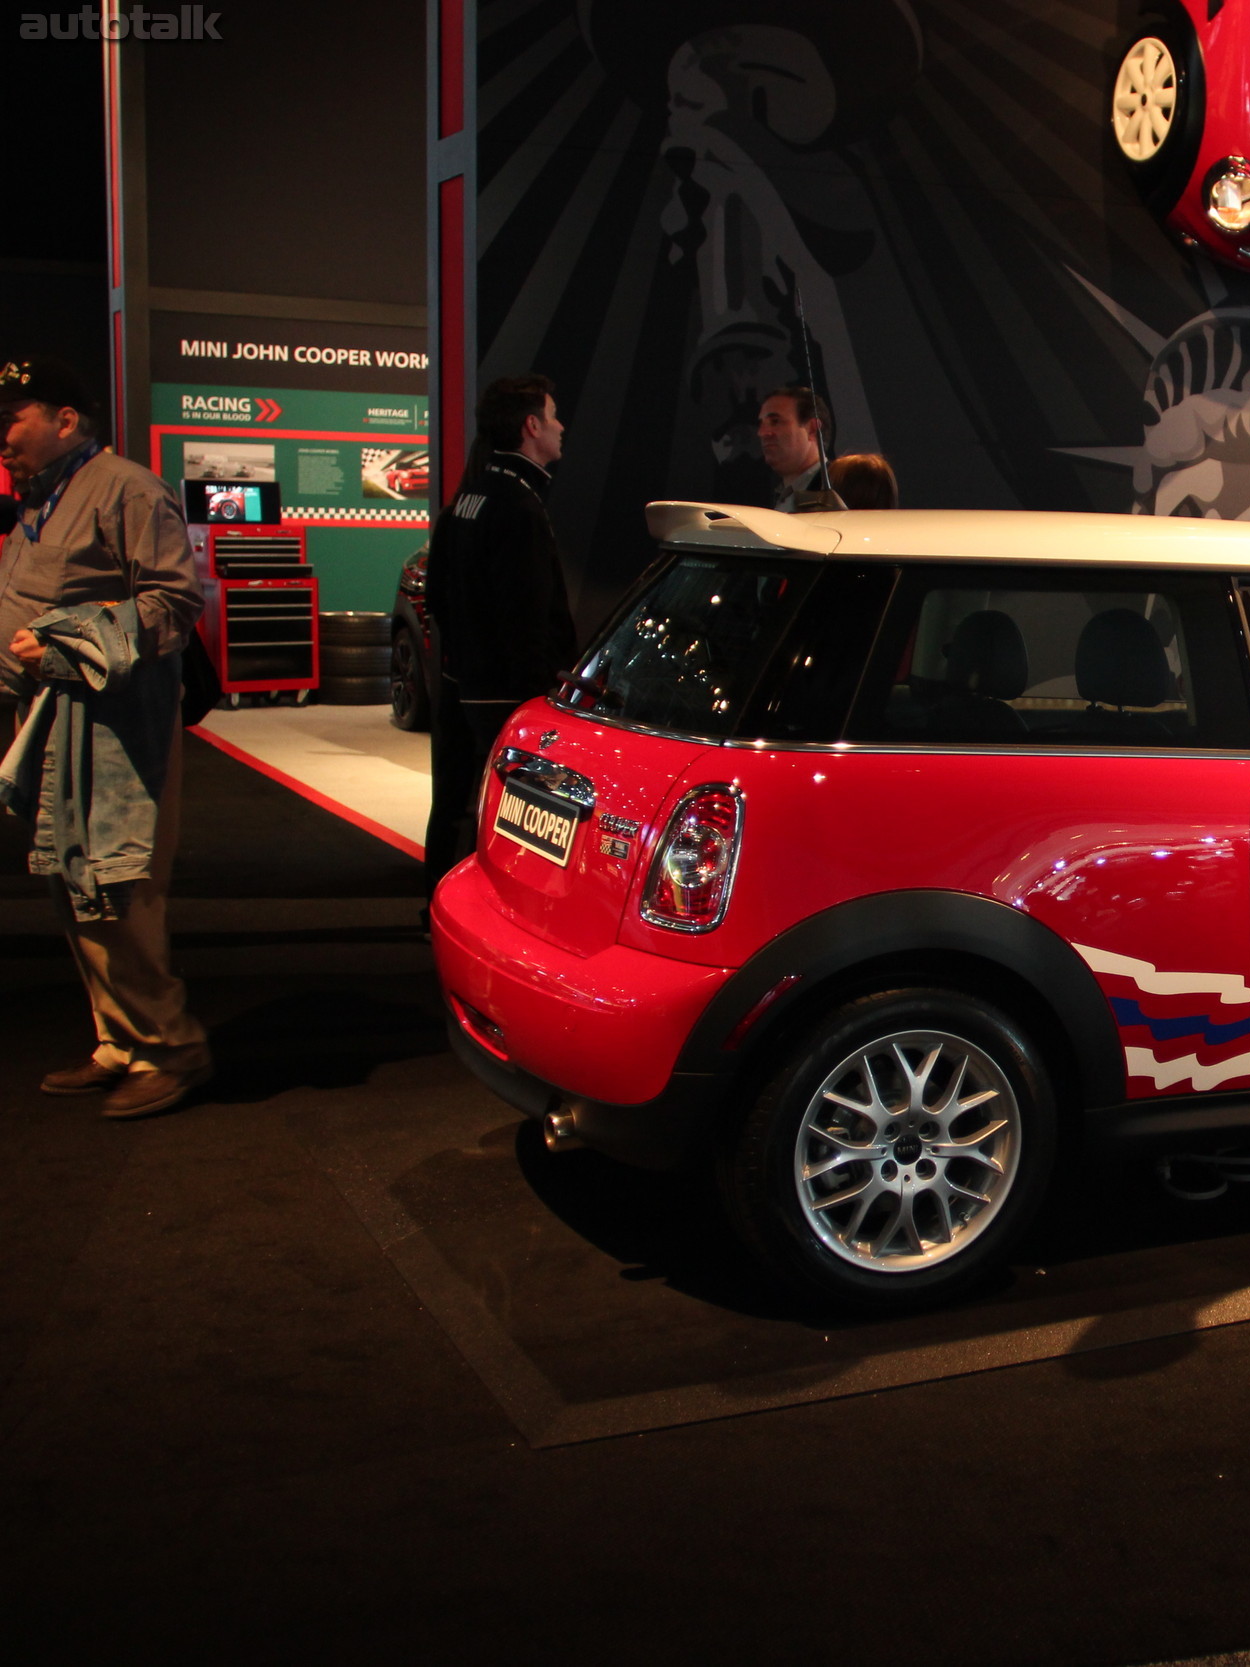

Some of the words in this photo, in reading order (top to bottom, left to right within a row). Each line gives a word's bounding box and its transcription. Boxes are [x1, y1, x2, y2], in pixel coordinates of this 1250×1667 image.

[181, 339, 228, 359] MINI
[232, 342, 289, 362] JOHN
[293, 346, 372, 366] COOPER
[181, 394, 251, 413] RACING
[367, 407, 409, 418] HERITAGE
[181, 410, 190, 419] IS
[192, 411, 201, 420] IN
[202, 412, 221, 421] OUR
[222, 412, 251, 421] BLOOD
[500, 792, 526, 827] MINI
[523, 804, 571, 849] COOPER
[598, 812, 641, 838] COOPER
